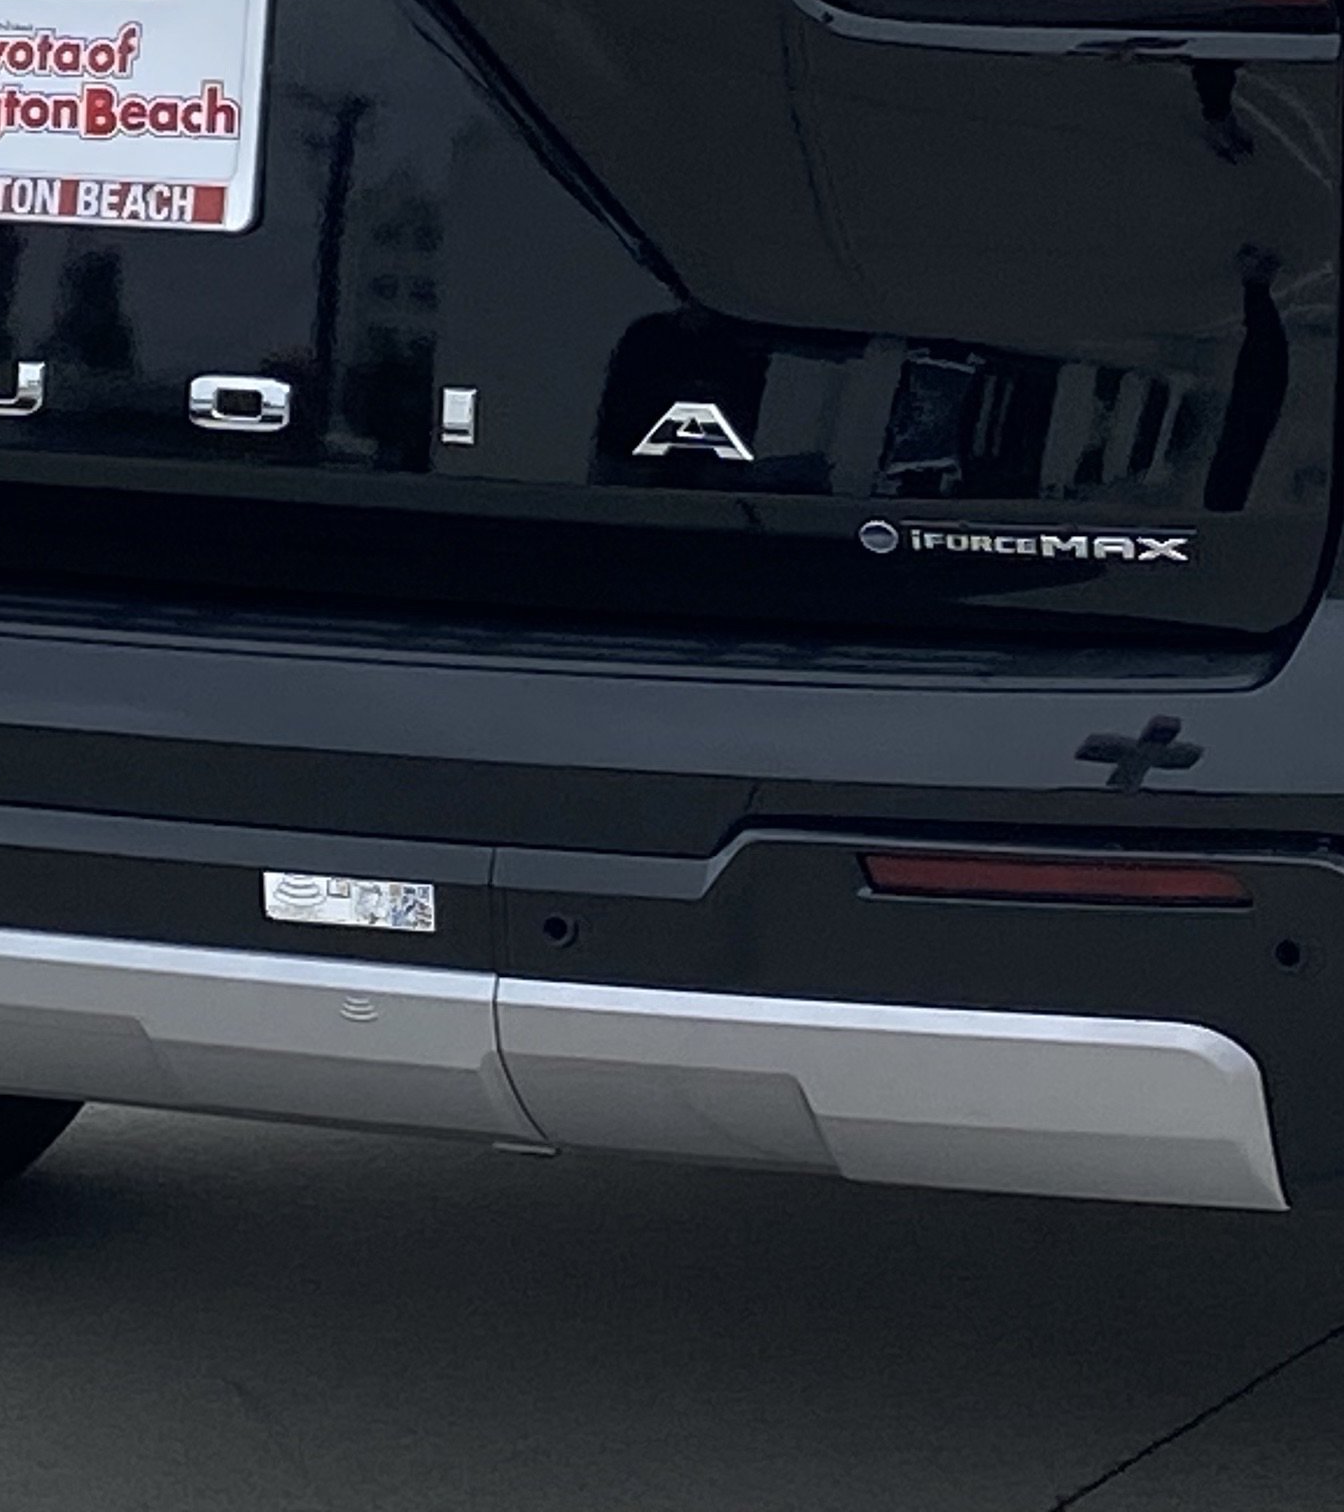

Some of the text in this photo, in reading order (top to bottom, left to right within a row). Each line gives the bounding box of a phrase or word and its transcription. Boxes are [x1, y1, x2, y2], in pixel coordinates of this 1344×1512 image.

[87, 24, 138, 75] of
[82, 86, 238, 137] Beach
[76, 182, 194, 222] BEACH
